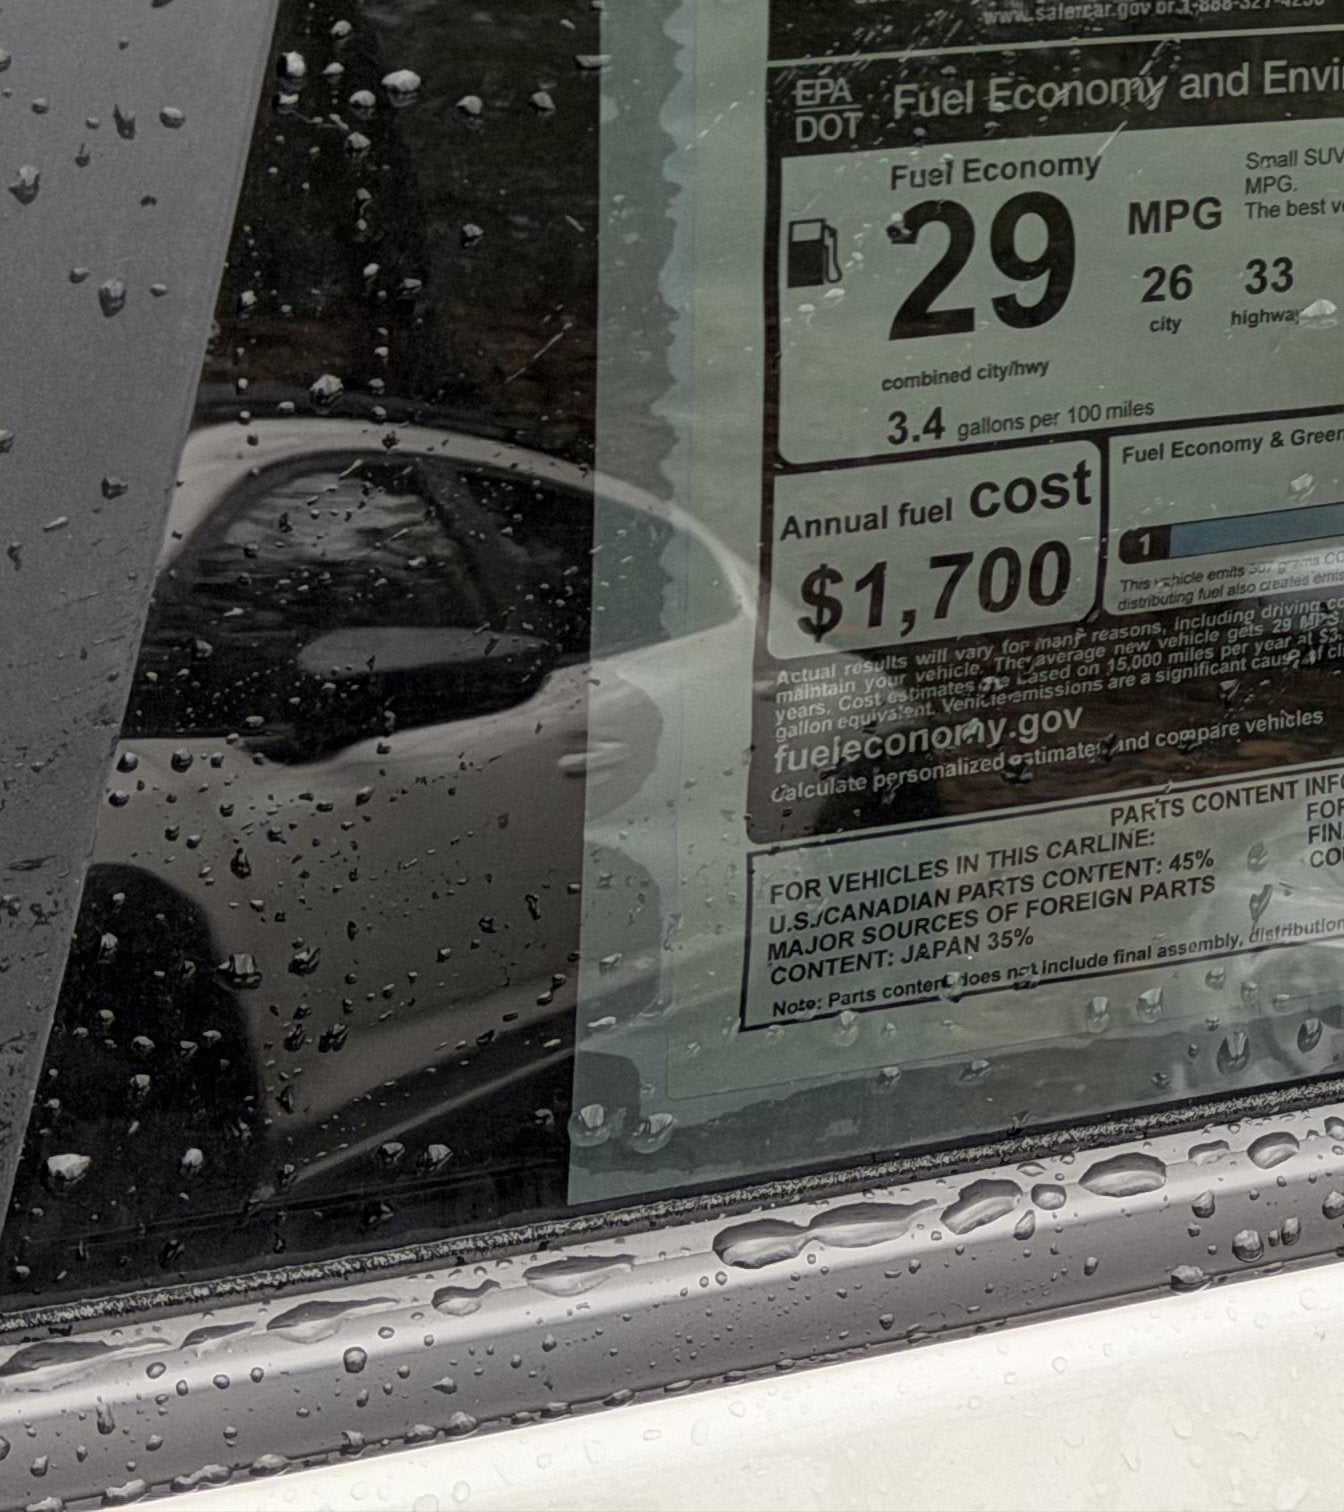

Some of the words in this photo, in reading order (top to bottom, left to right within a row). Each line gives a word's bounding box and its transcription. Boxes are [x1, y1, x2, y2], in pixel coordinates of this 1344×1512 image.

[795, 77, 852, 108] EPA
[893, 77, 975, 120] Fuel
[983, 74, 1166, 114] Economy
[1179, 60, 1250, 102] and
[795, 112, 862, 143] DOT
[890, 161, 955, 190] Fuel
[962, 157, 1104, 186] Economy
[1245, 147, 1299, 169] Small
[1243, 199, 1281, 220] The
[1285, 197, 1327, 217] best
[1244, 175, 1298, 196] MPG.
[1127, 195, 1223, 235] MPG
[888, 190, 1077, 341] 29
[1140, 263, 1194, 304] 26
[1244, 255, 1295, 296] 33
[1149, 314, 1182, 334] city
[881, 363, 972, 390] combined
[976, 358, 1050, 384] city/hwy
[887, 404, 946, 444] 3.4
[957, 412, 1026, 440] gallons
[1029, 410, 1061, 433] per
[1067, 401, 1102, 425] 100
[1105, 398, 1155, 421] miles
[1122, 440, 1165, 464] Fuel
[1170, 434, 1264, 459] Economy
[1269, 427, 1285, 448] &
[779, 501, 889, 541] Annual
[897, 493, 953, 528] fuel
[969, 459, 1093, 519] cost
[796, 539, 1073, 643] $1,700
[773, 705, 1084, 774] fueleconomy.gov
[1110, 793, 1185, 826] PARTS
[1191, 776, 1300, 814] CONTENT
[769, 876, 822, 905] FOR
[827, 856, 949, 896] VEHICLES
[956, 851, 980, 877] IN
[985, 842, 1039, 872] THIS
[1045, 826, 1155, 863] CARLINE:
[769, 886, 951, 935] U.S./CANADIAN
[956, 874, 1035, 907] PARTS
[1042, 855, 1163, 894] CONTENT:
[1168, 846, 1215, 875] 45%
[767, 926, 855, 961] MAJOR
[861, 907, 979, 947] SOURCES
[985, 901, 1020, 928] OF
[1025, 884, 1133, 922] FOREIGN
[1139, 871, 1216, 904] PARTS
[768, 946, 894, 986] CONTENT:
[900, 931, 985, 966] JAPAN
[984, 924, 1034, 953] 35%
